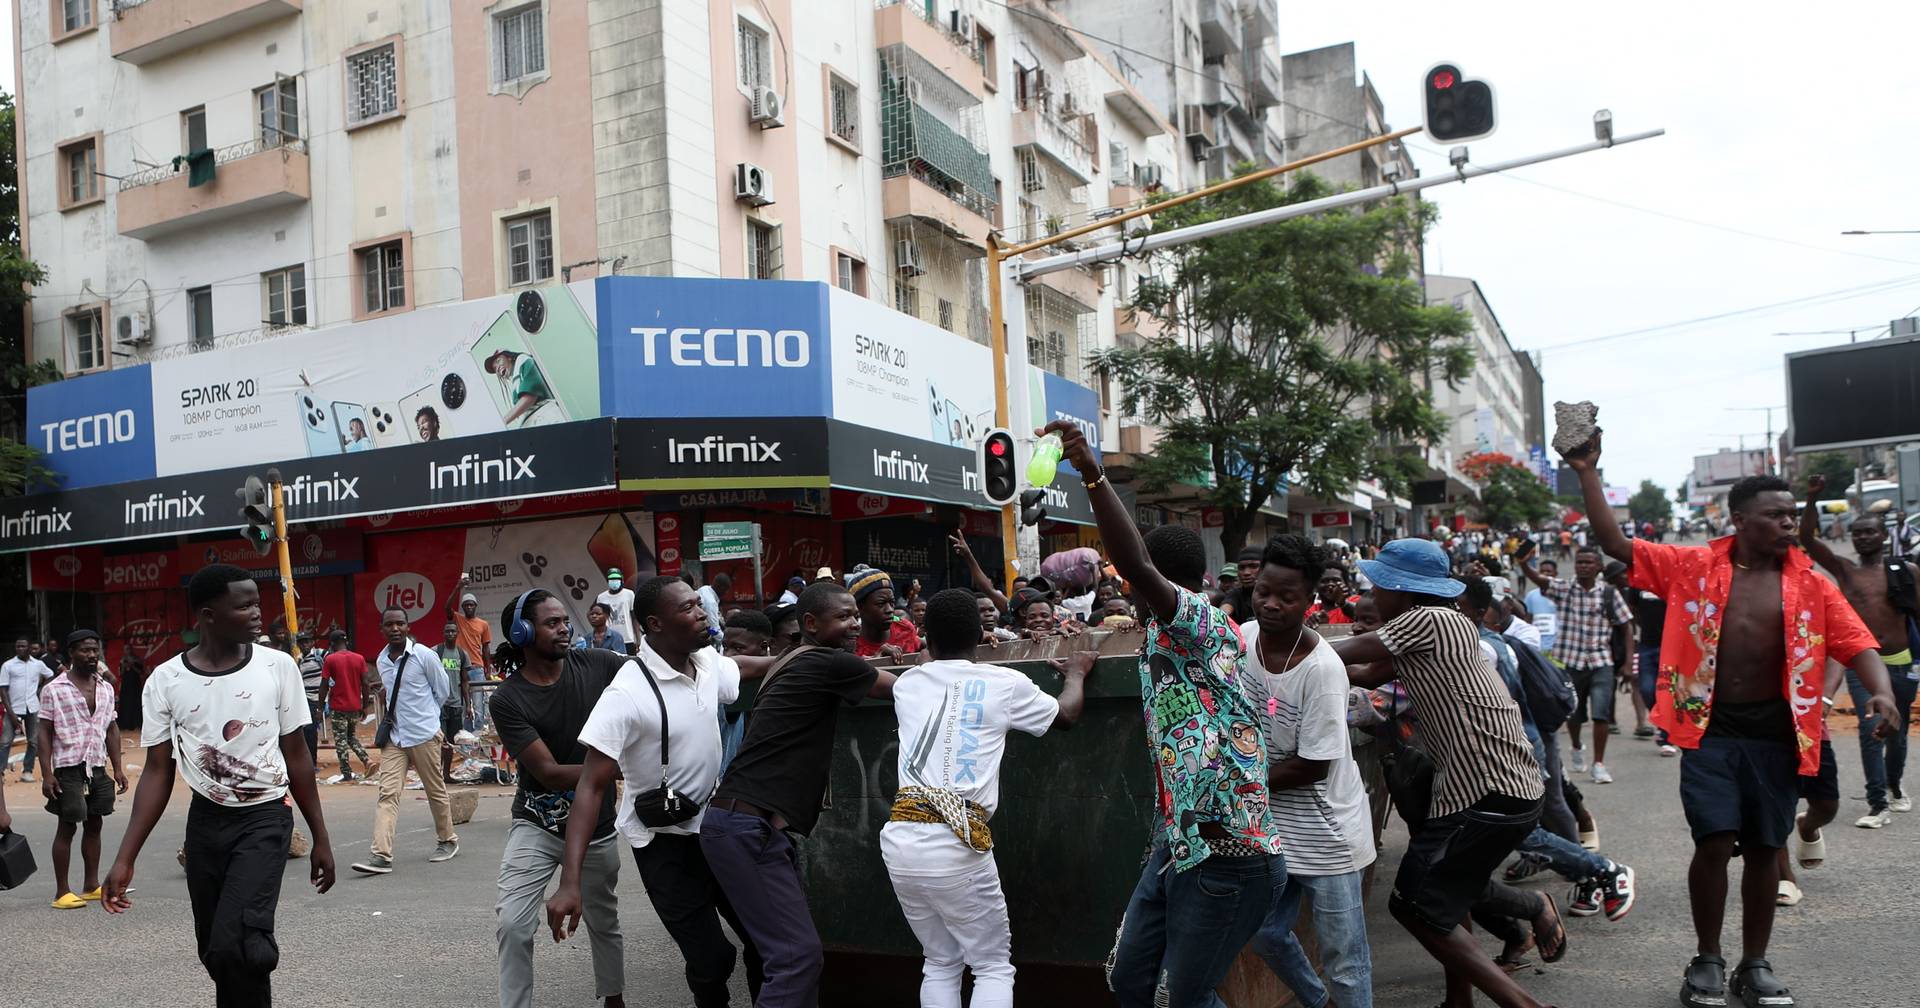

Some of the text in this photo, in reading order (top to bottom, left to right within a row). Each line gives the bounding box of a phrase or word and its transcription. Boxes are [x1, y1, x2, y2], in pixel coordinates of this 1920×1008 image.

[630, 327, 810, 368] TECNO
[855, 334, 906, 369] SPARK 20
[878, 367, 910, 388] Champion
[181, 382, 232, 408] SPARK
[236, 378, 255, 399] 20
[183, 403, 261, 425] 108MP Champion
[40, 408, 136, 454] TECNO
[668, 435, 782, 464] Infinix
[429, 449, 537, 490] Infinix
[873, 448, 930, 484] Infinix
[125, 489, 205, 524] Infinix
[680, 489, 768, 507] CASA HAJRA
[863, 496, 884, 509] itel
[0, 506, 72, 538] Infinix
[703, 544, 750, 555] GUERRA POPULAR
[799, 544, 824, 566] itel
[867, 531, 930, 572] Mozpoint
[249, 569, 273, 579] DEDOR
[493, 564, 506, 577] 4G
[385, 581, 425, 610] itel
[1170, 704, 1201, 725] LOVE
[942, 680, 962, 787] Sailboat Racing Products
[954, 679, 986, 784] SOAK
[1178, 737, 1196, 752] MILK
